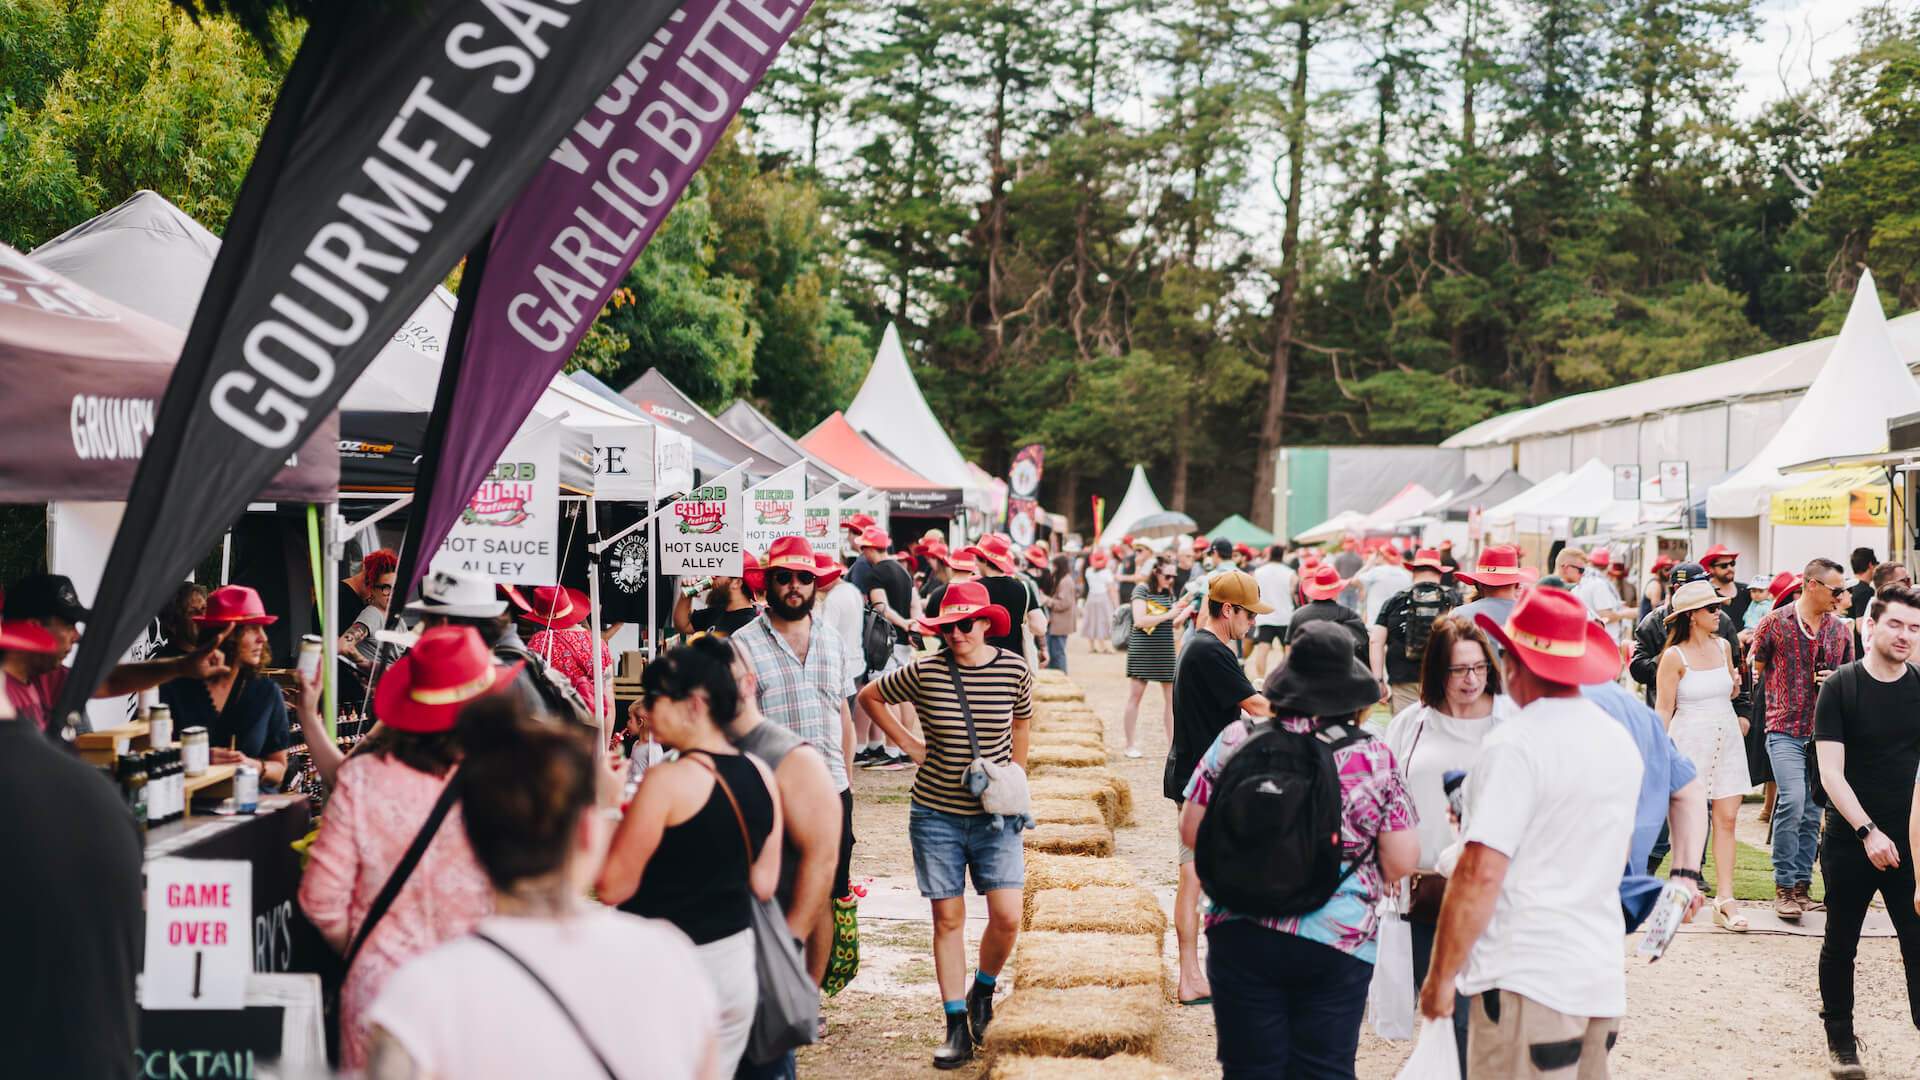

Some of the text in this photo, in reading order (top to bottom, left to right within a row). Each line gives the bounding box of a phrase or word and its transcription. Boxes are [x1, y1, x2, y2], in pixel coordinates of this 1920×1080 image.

[507, 0, 811, 352] GARLIC BUTTE
[210, 0, 582, 449] GOURMET SA
[476, 483, 533, 502] HILLI
[682, 486, 727, 500] ERB
[674, 502, 726, 516] CHILLI
[746, 531, 766, 540] HOT
[442, 536, 550, 555] HOT SAUCE
[613, 534, 649, 561] MELBOUR
[665, 542, 739, 553] HOT SAUCE
[681, 558, 724, 568] ALLEY
[167, 883, 232, 908] GAME
[168, 921, 229, 945] OVER
